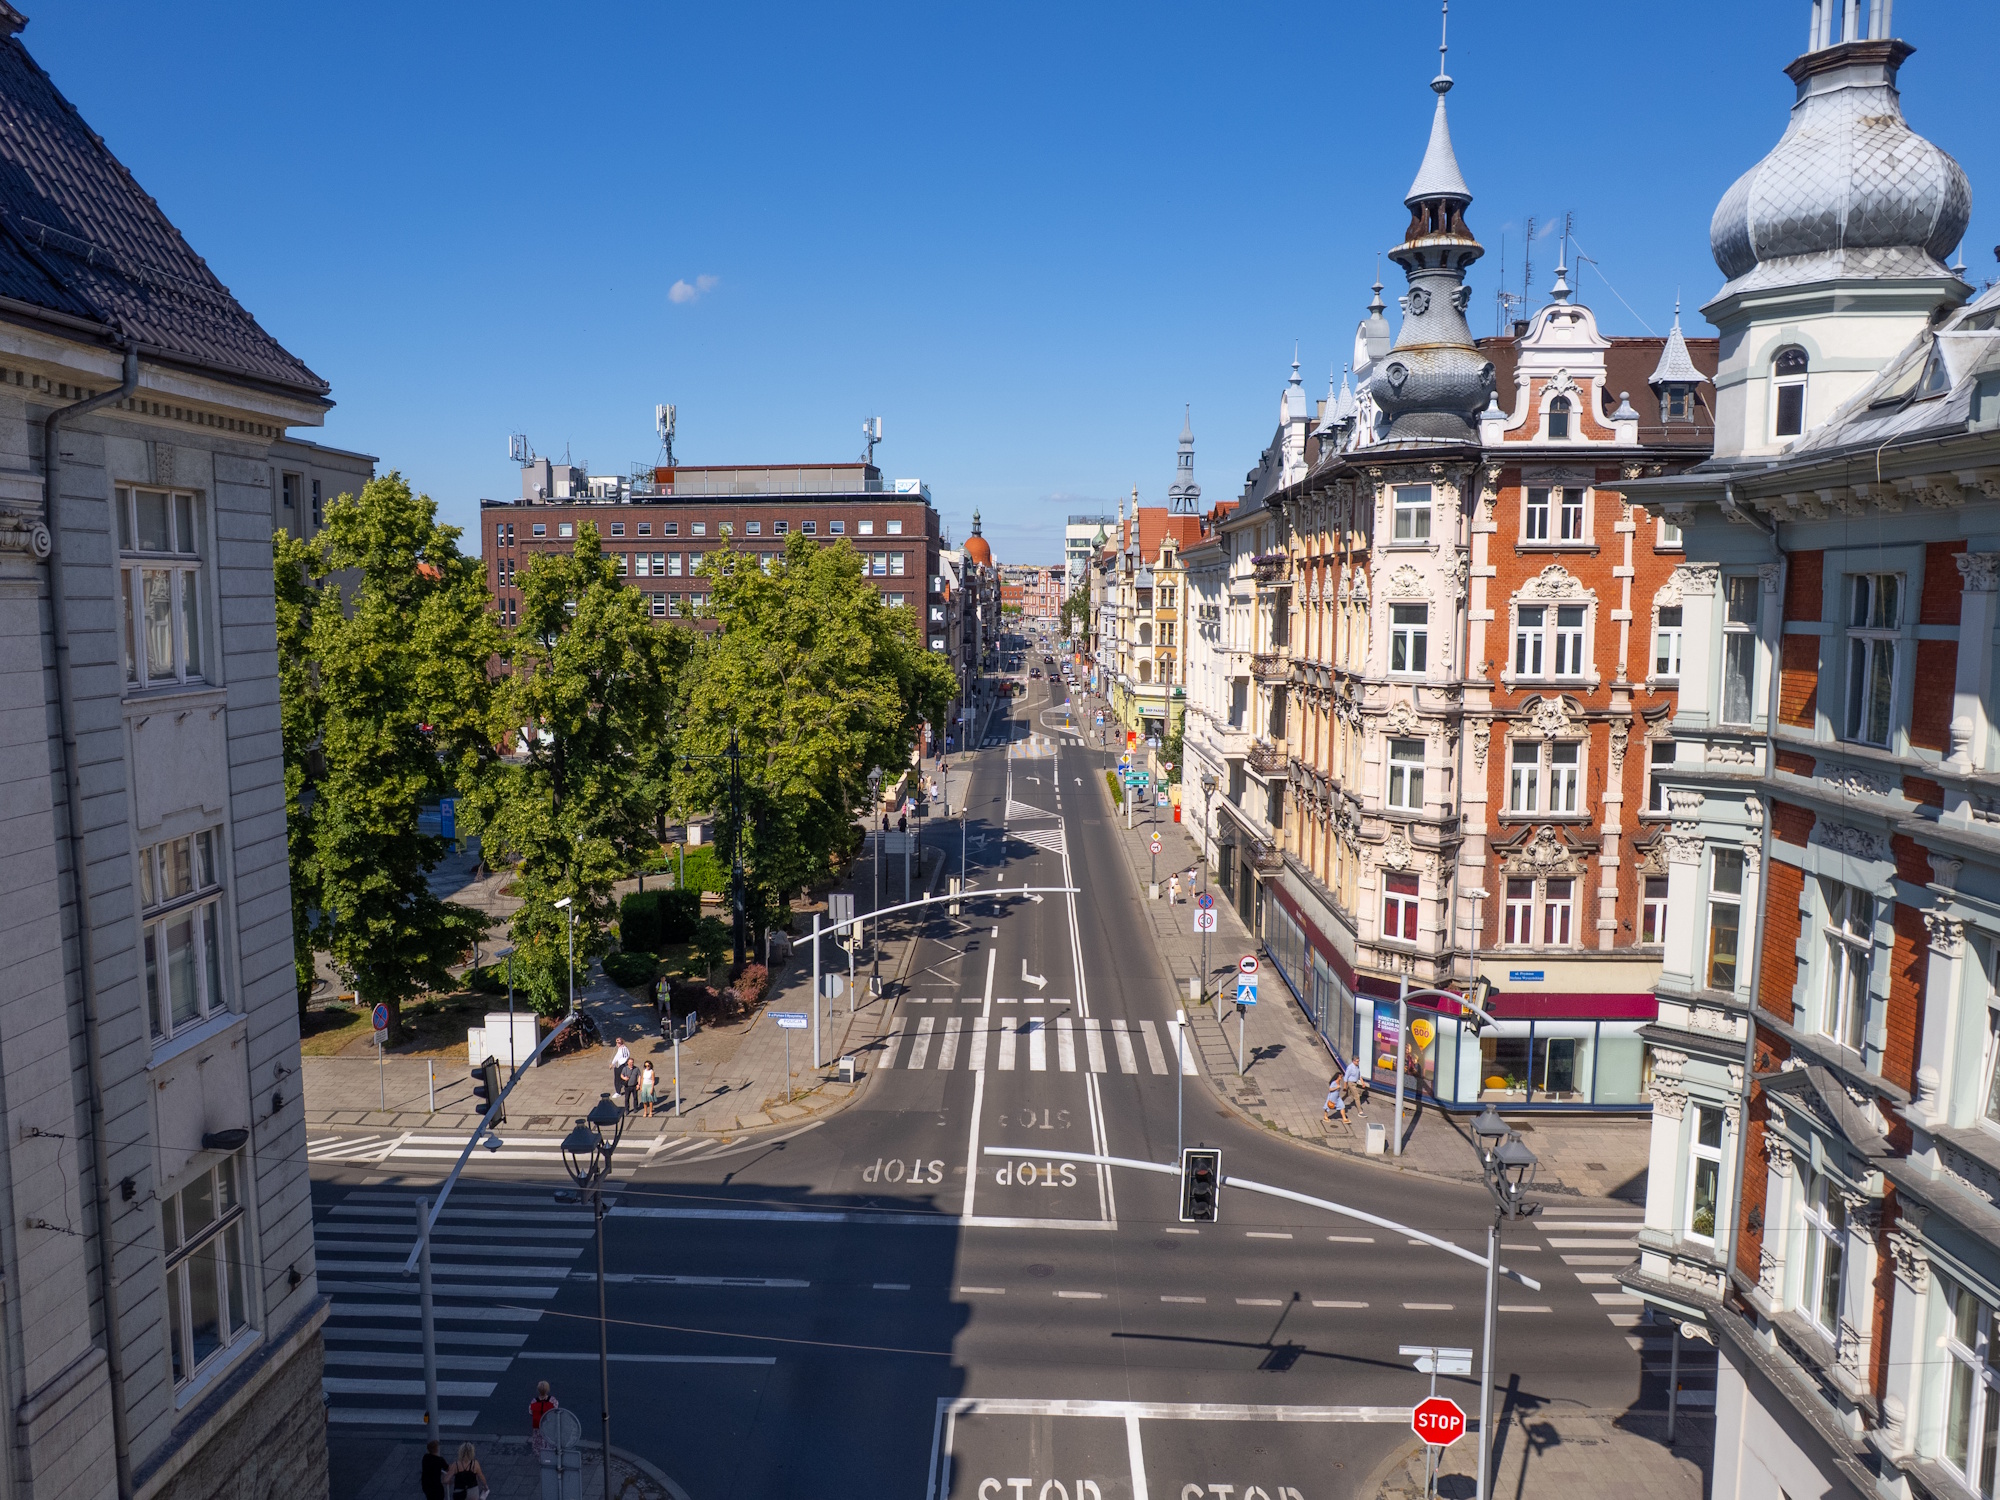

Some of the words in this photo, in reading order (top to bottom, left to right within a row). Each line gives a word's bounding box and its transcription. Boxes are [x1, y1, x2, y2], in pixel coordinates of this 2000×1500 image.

[1414, 1028, 1429, 1038] 800
[862, 1158, 946, 1184] STOP
[995, 1161, 1077, 1187] STOP
[1418, 1413, 1460, 1430] STOP
